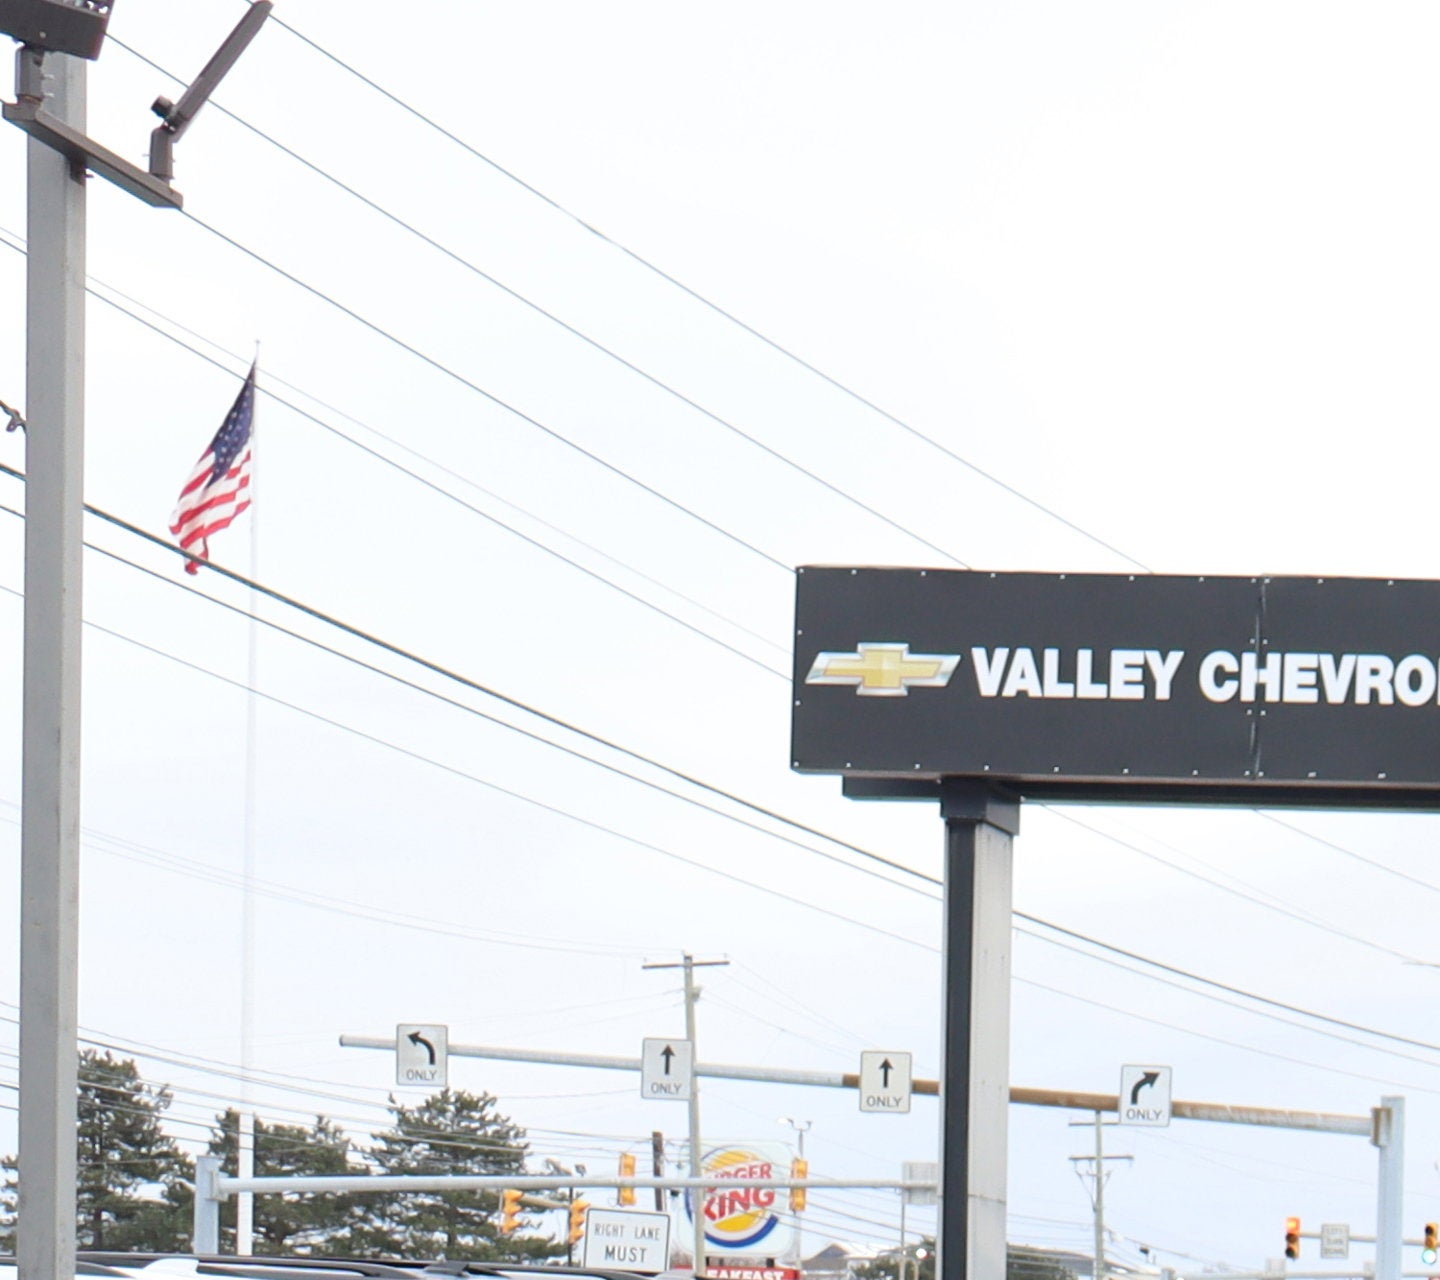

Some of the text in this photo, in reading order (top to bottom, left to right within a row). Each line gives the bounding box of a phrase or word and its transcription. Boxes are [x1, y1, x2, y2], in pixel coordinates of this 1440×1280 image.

[971, 646, 1185, 700] VALLEY
[406, 1069, 438, 1082] ONLY
[650, 1082, 683, 1095] ONLY
[866, 1095, 902, 1108] ONLY
[1126, 1108, 1162, 1121] ONLY
[594, 1222, 661, 1241] RIGHT LANE
[604, 1245, 648, 1264] MUST
